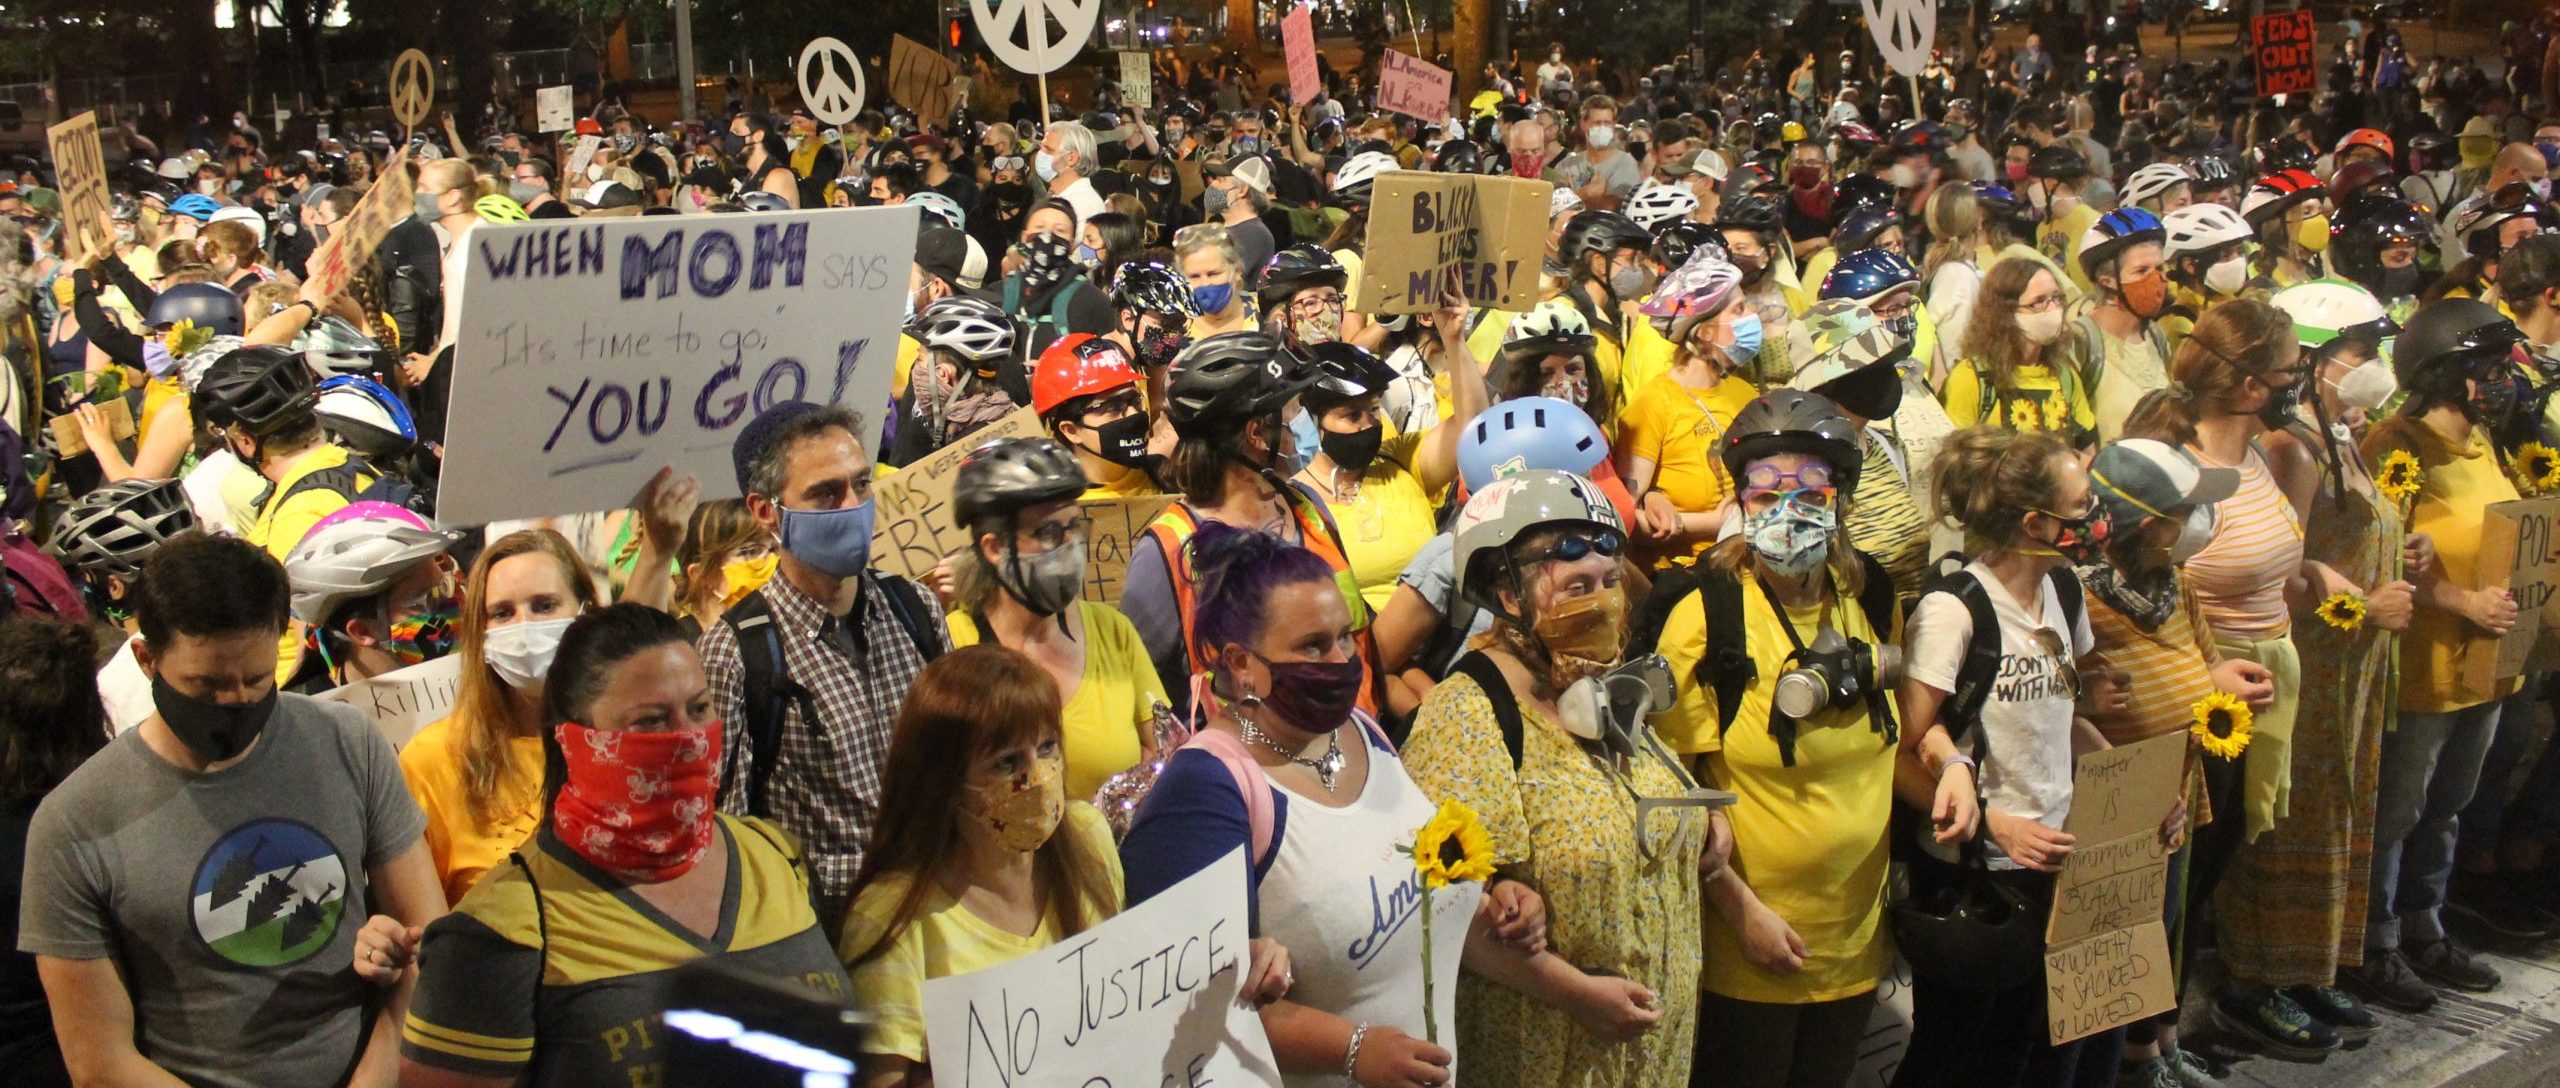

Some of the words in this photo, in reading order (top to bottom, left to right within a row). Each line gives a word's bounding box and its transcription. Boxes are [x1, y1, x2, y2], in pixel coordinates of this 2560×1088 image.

[2252, 13, 2308, 46] FEDS
[2261, 42, 2310, 69] OUT
[2265, 68, 2312, 94] NOW
[1412, 184, 1469, 234] BLACK
[480, 224, 605, 281] WHEN
[619, 221, 810, 301] MOM
[821, 252, 889, 291] SAYS
[1437, 227, 1479, 266] LIVES
[664, 311, 700, 356] to
[542, 375, 672, 453] YOU
[1119, 438, 1144, 447] BLACK
[1998, 654, 2051, 678] DON'T
[1996, 671, 2044, 702] WITH
[2059, 879, 2131, 916] BLACK
[2068, 928, 2135, 976] WORTHY
[2072, 953, 2151, 1011] SACRED
[2073, 991, 2145, 1036] LOVED
